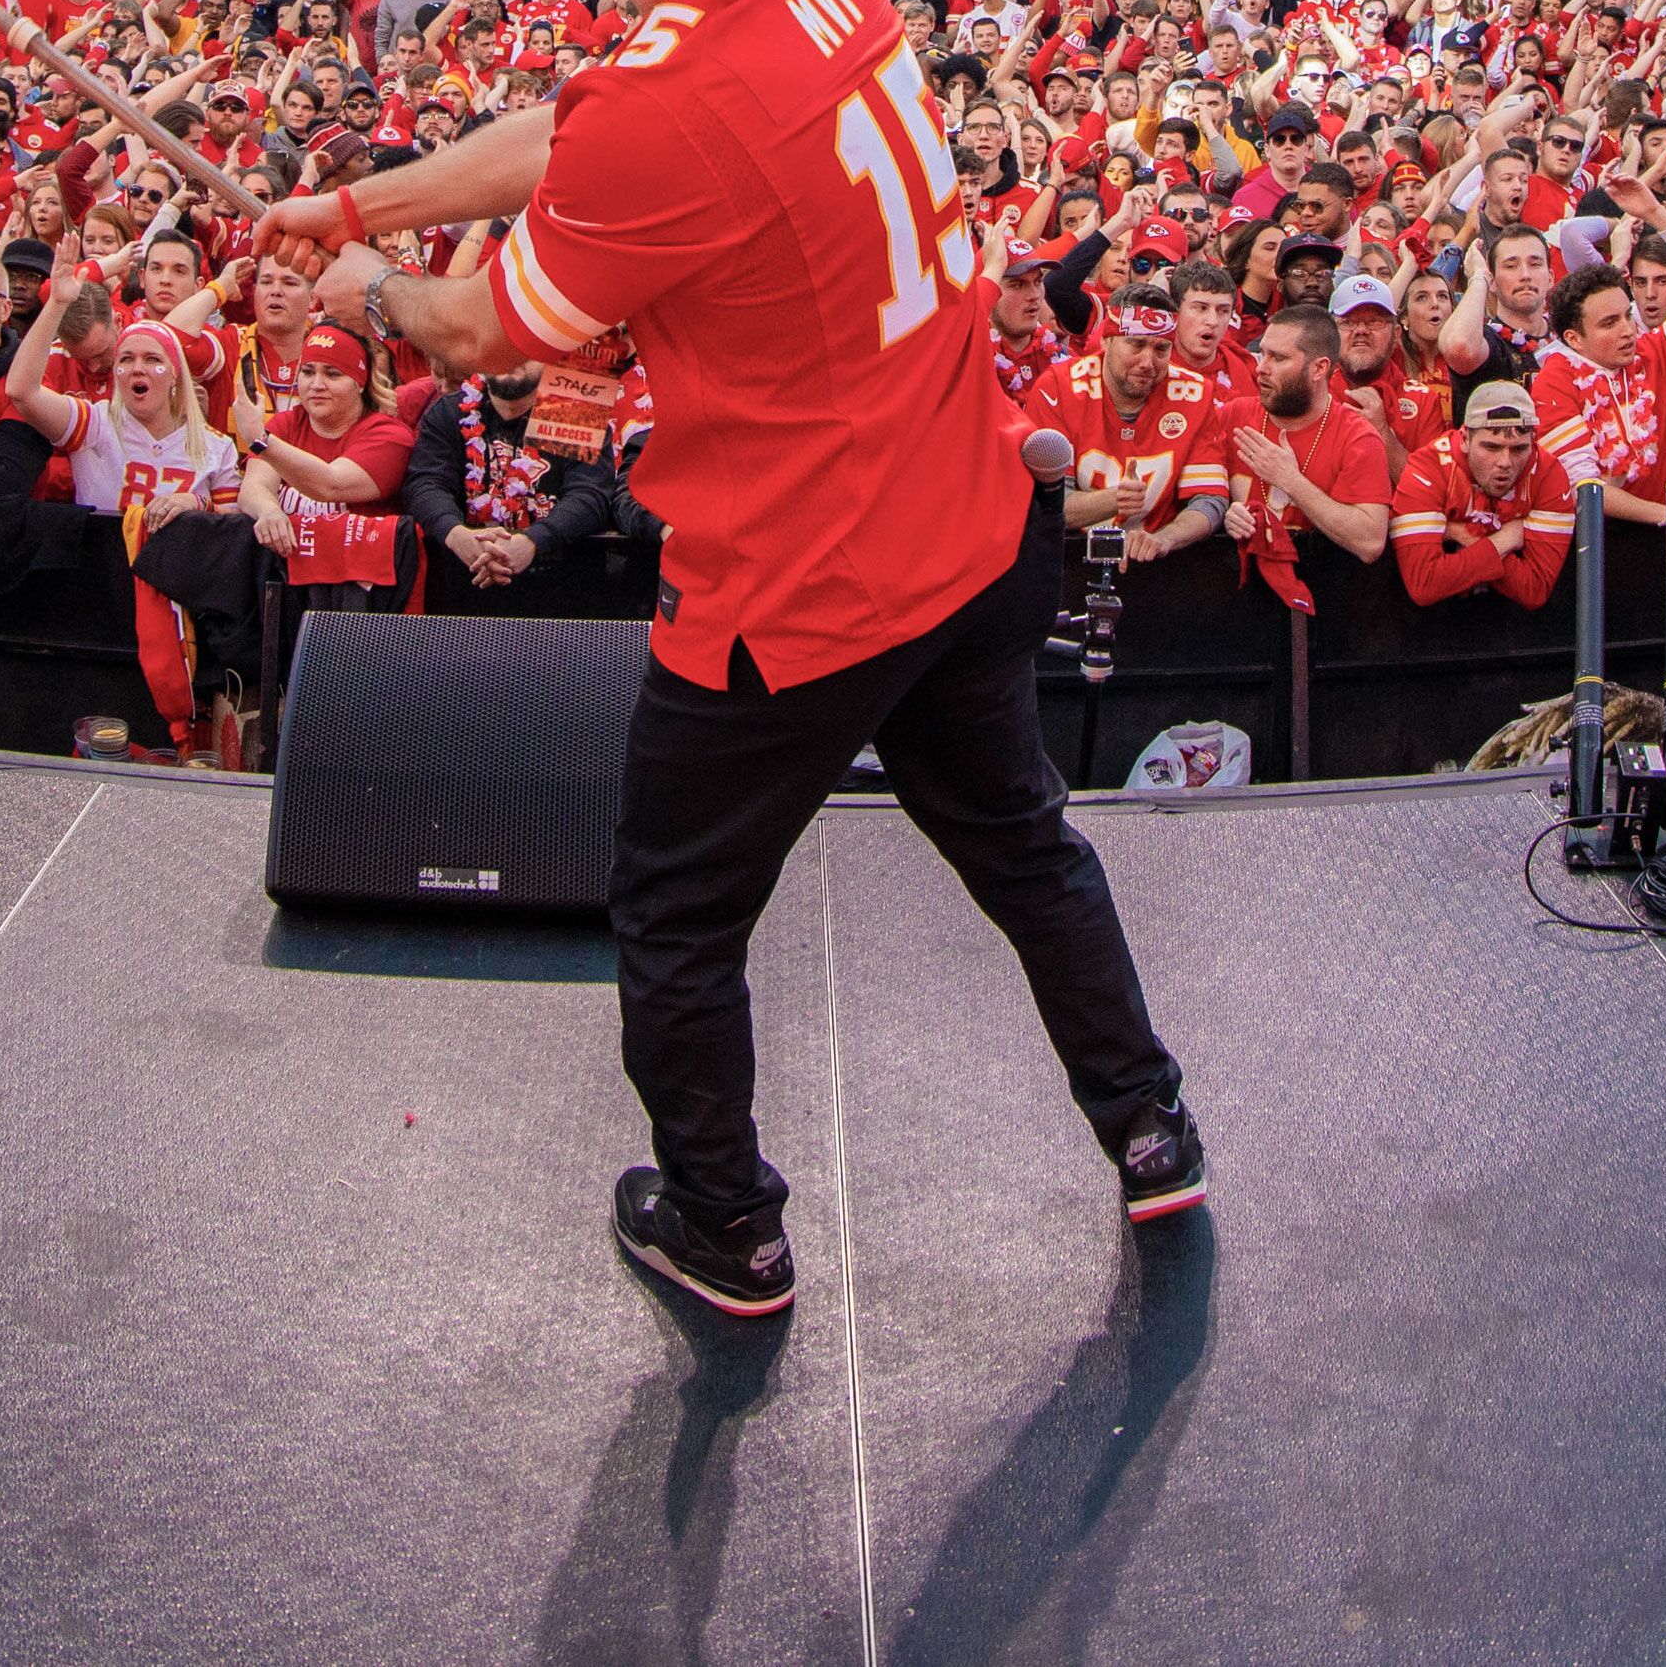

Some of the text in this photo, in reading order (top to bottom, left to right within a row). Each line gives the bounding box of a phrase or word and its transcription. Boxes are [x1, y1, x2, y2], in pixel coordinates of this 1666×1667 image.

[600, 2, 705, 69] 5
[834, 33, 976, 351] 15
[1166, 363, 1204, 403] 87
[537, 424, 593, 443] ALL ACCESS
[418, 879, 477, 890] audiotechnik
[419, 867, 443, 879] d&b
